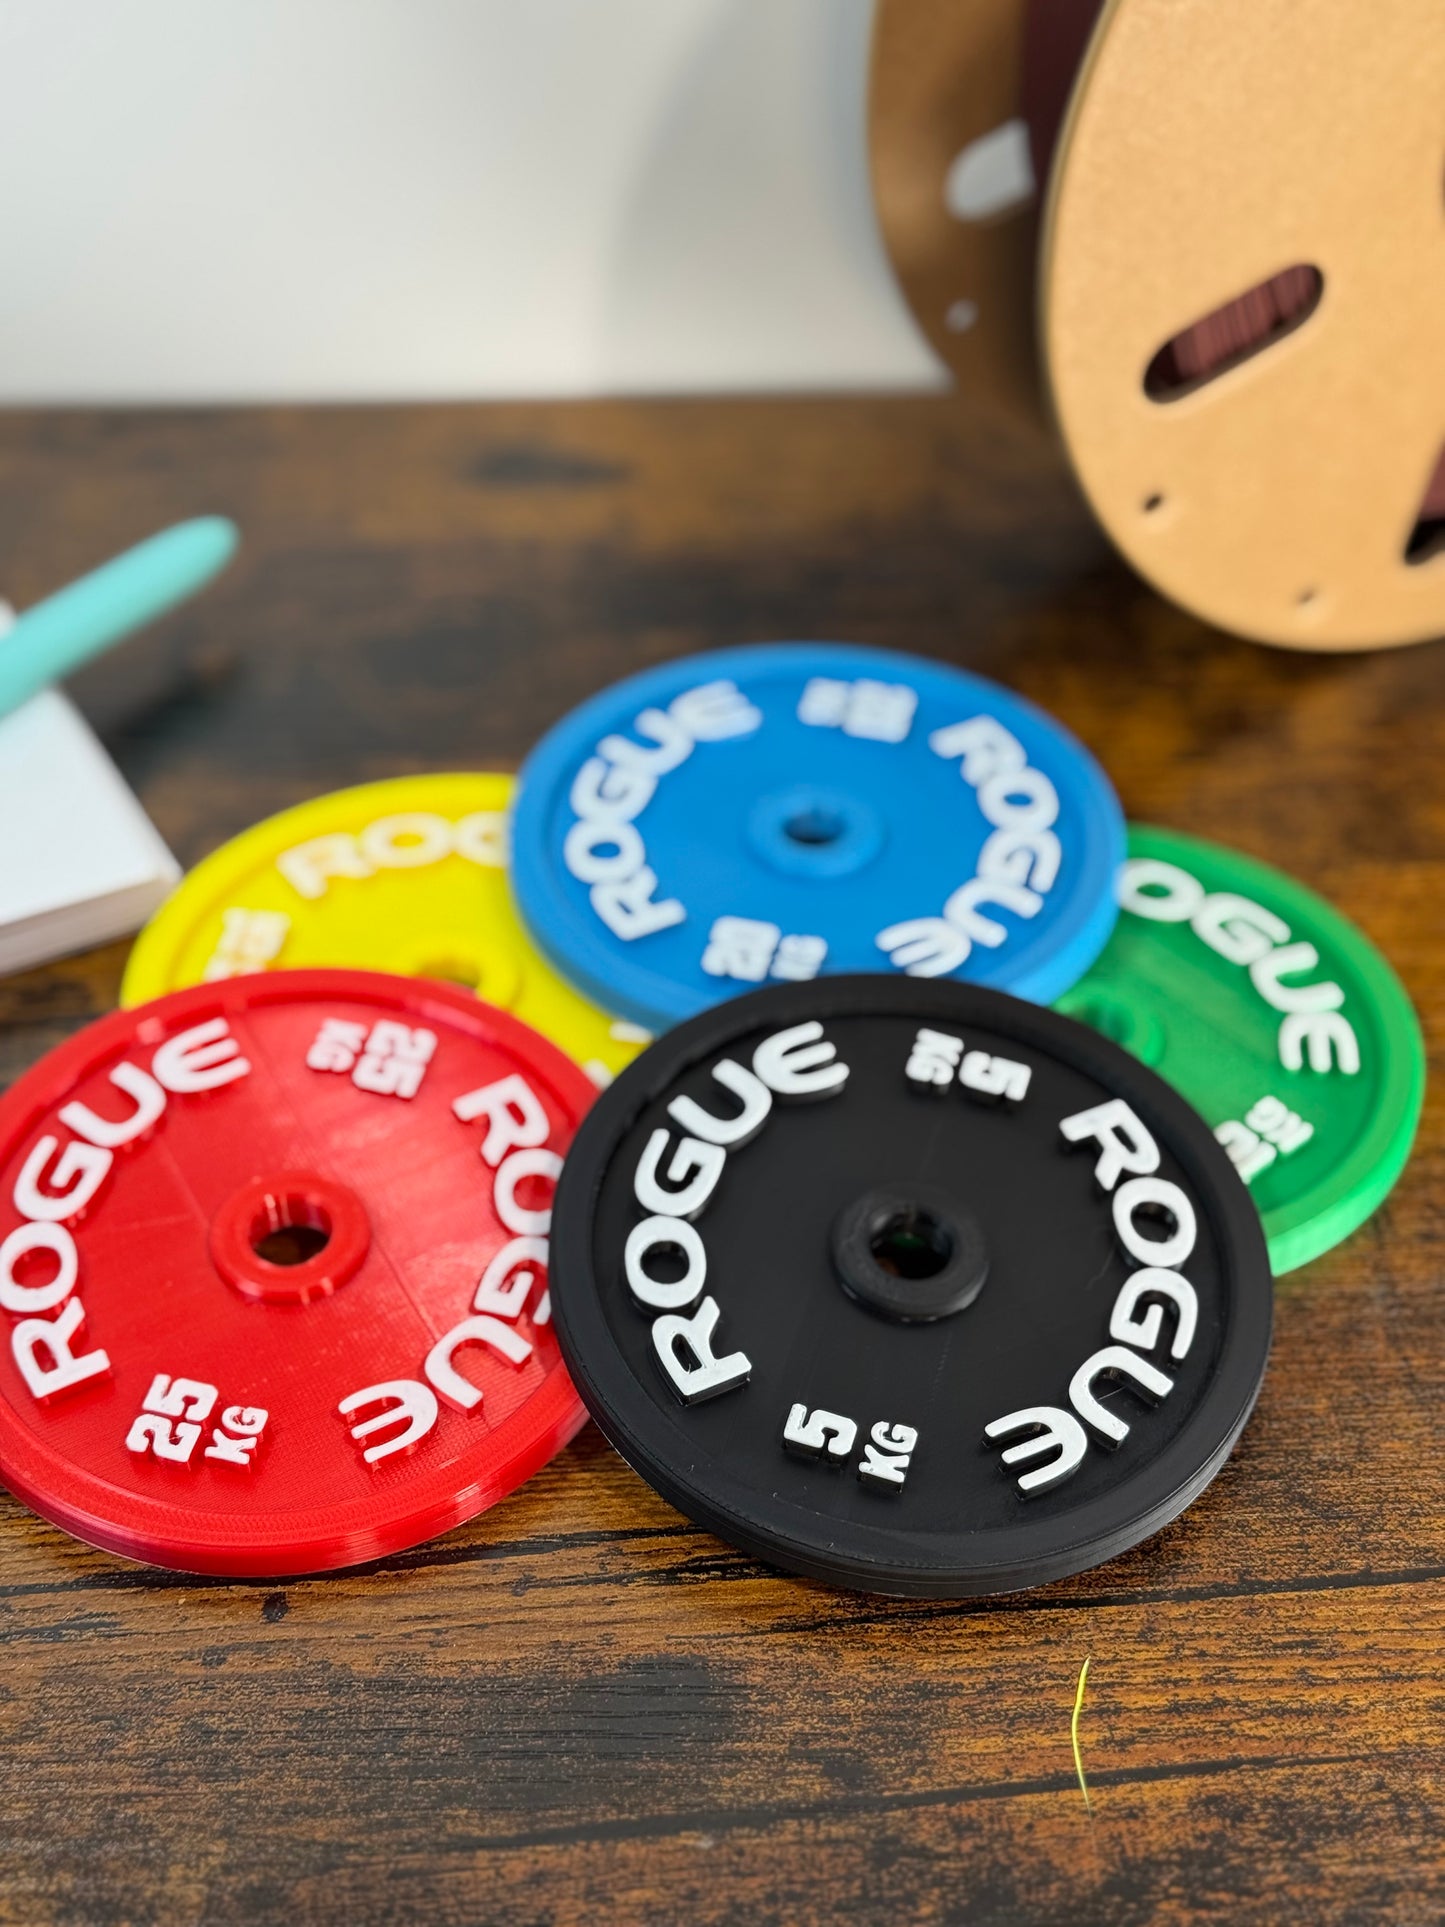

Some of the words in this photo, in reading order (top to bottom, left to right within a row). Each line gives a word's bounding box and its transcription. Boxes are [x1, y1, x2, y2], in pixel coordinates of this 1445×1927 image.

[565, 680, 763, 940] ROGUE
[876, 714, 1061, 978] ROGUE
[352, 1018, 438, 1098] 25
[905, 1028, 964, 1085] KG
[959, 1050, 1032, 1101] 5
[1116, 858, 1361, 1075] OGUE
[0, 1017, 251, 1398] ROGUE
[338, 1073, 564, 1463] ROGUE
[624, 1020, 850, 1398] ROGUE
[984, 1098, 1199, 1491] ROGUE
[126, 1374, 219, 1463] 25
[205, 1405, 269, 1465] KG
[783, 1403, 858, 1458] 5
[858, 1421, 918, 1486] KG
